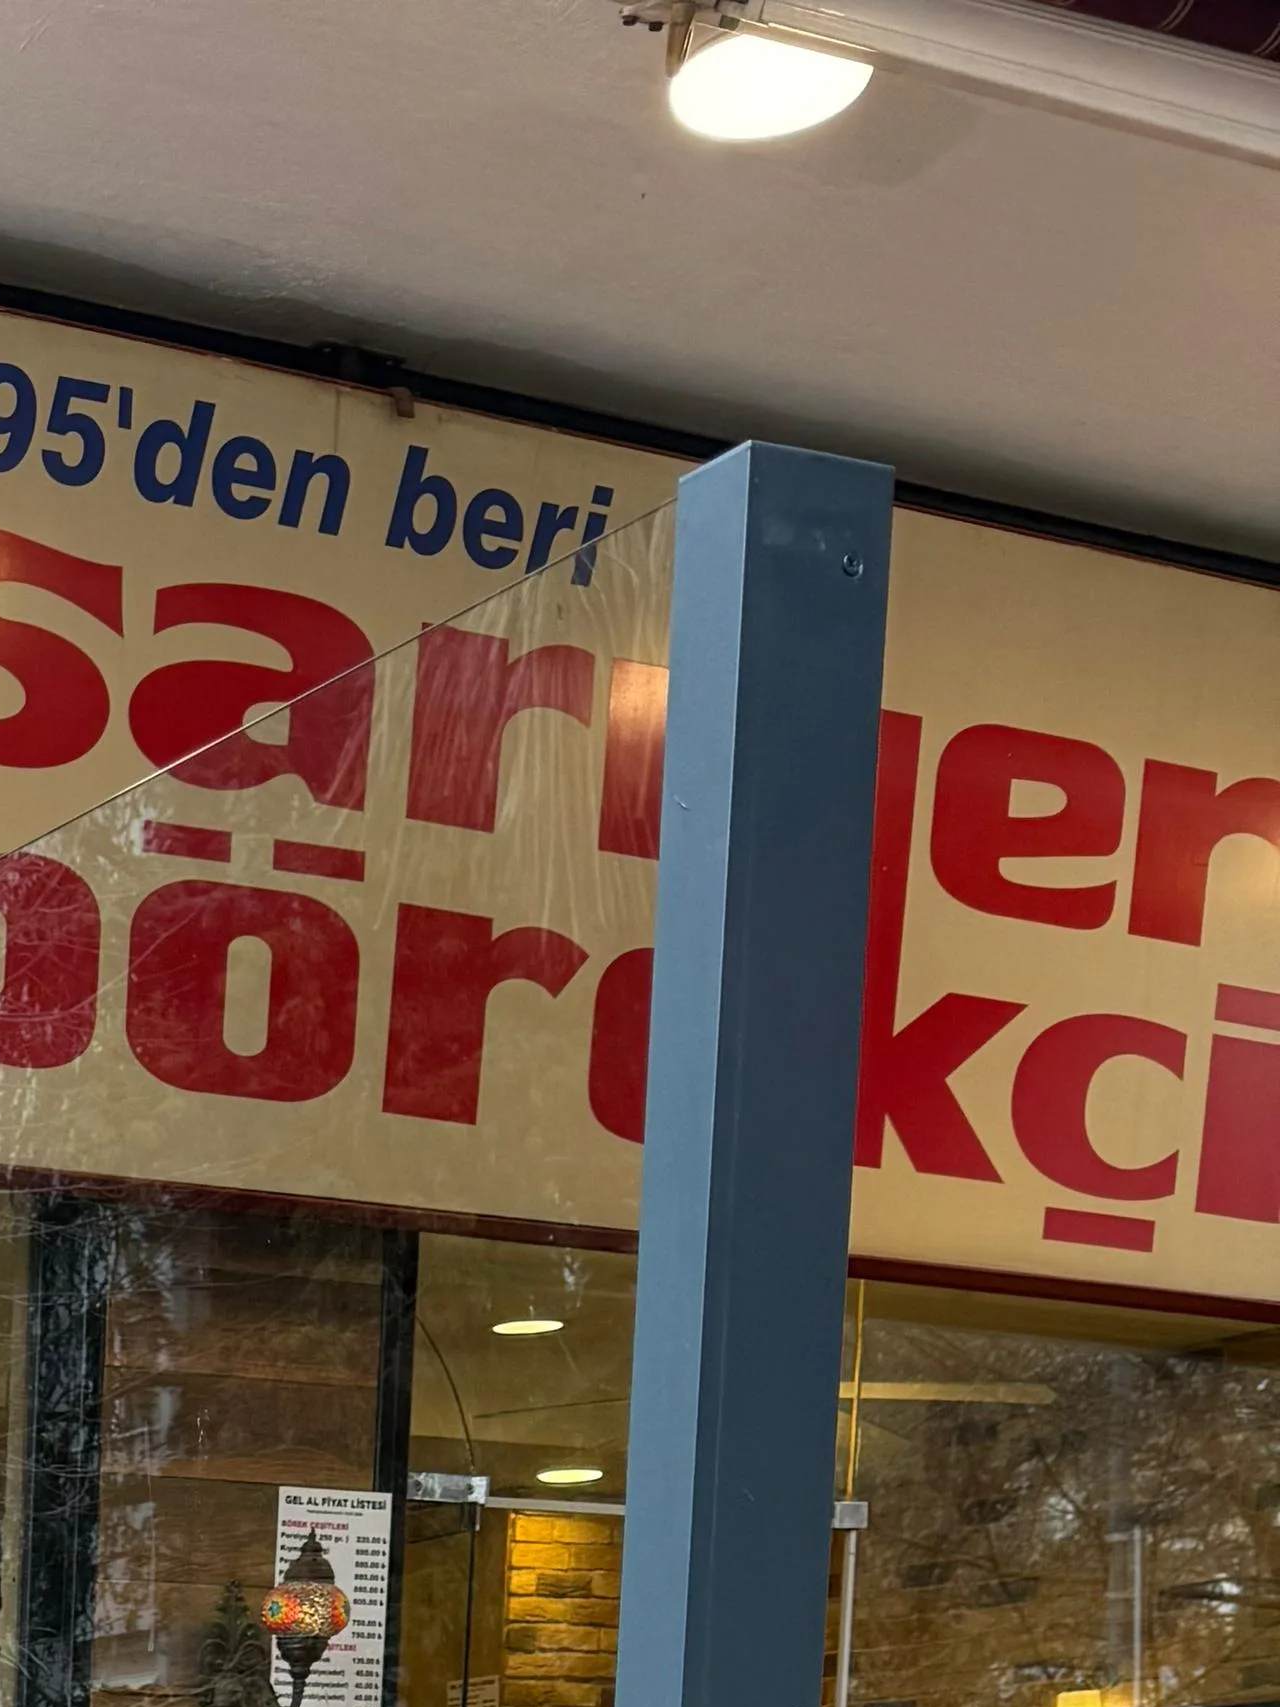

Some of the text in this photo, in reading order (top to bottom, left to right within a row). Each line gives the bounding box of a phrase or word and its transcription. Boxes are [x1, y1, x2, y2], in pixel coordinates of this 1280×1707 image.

[385, 446, 615, 587] beri
[285, 1495, 386, 1510] GEL AL FİYAT LİSTESİ
